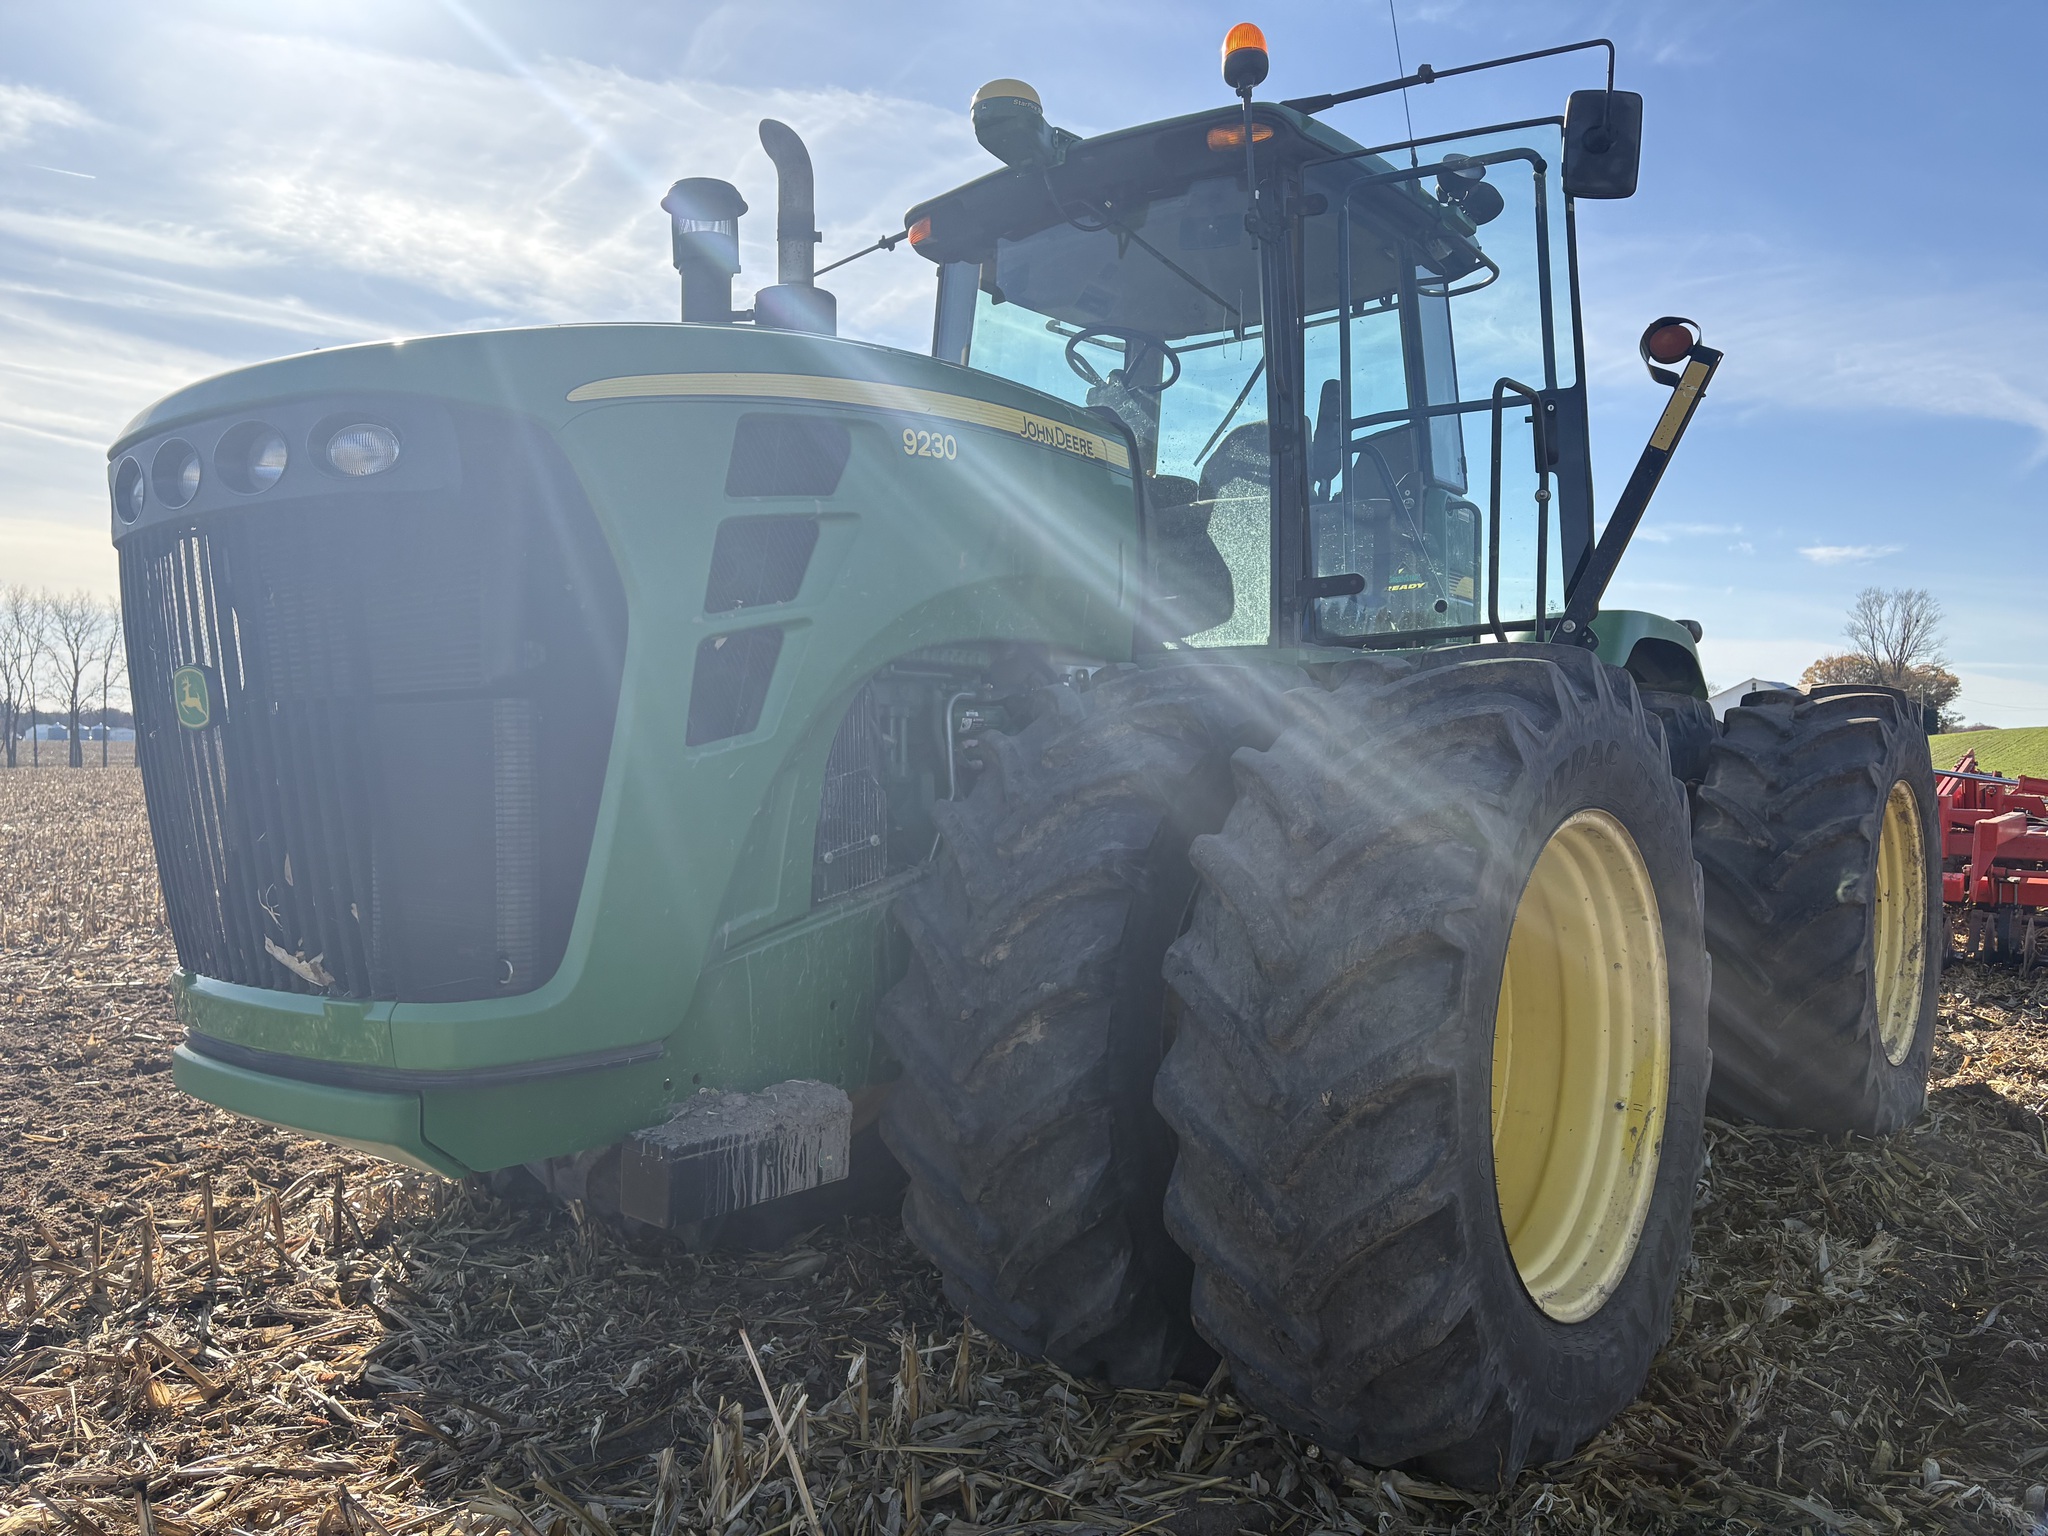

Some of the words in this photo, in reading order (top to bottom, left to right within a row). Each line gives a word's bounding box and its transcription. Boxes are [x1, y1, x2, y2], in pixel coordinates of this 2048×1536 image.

[902, 428, 957, 460] 9230
[1020, 415, 1055, 445] JOHN
[1055, 426, 1095, 457] DEERE
